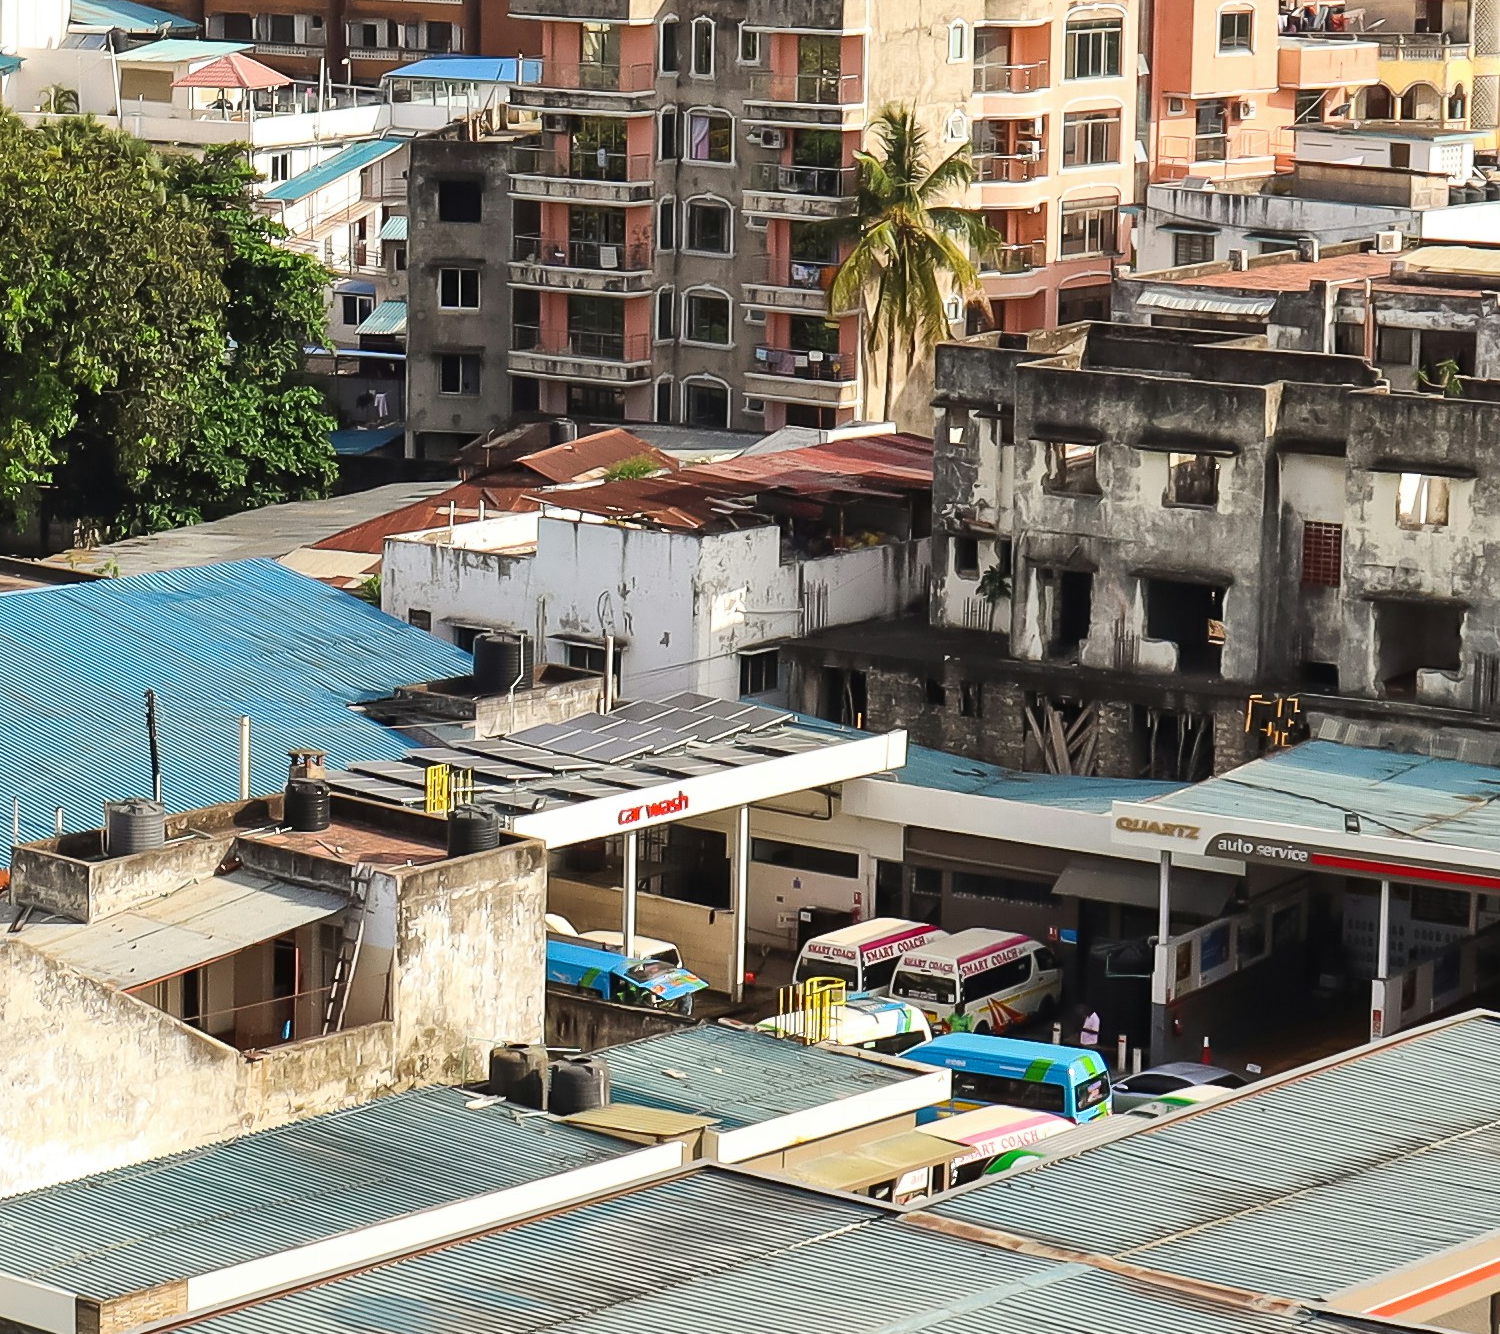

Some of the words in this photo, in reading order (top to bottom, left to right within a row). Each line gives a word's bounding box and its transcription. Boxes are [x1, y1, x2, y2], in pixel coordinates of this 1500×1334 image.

[617, 805, 643, 825] car
[645, 790, 689, 819] wash
[1115, 816, 1202, 840] QUARTZ
[1217, 838, 1254, 855] auto
[1255, 844, 1309, 863] service
[807, 943, 831, 956] SMART
[831, 947, 856, 960] COACH
[866, 944, 894, 963] SMART
[897, 935, 926, 954] COACH
[903, 957, 928, 969] SMART
[928, 960, 954, 973] COACH
[961, 959, 989, 977] SMART
[990, 948, 1019, 966] COACH
[1001, 1129, 1039, 1149] COACH
